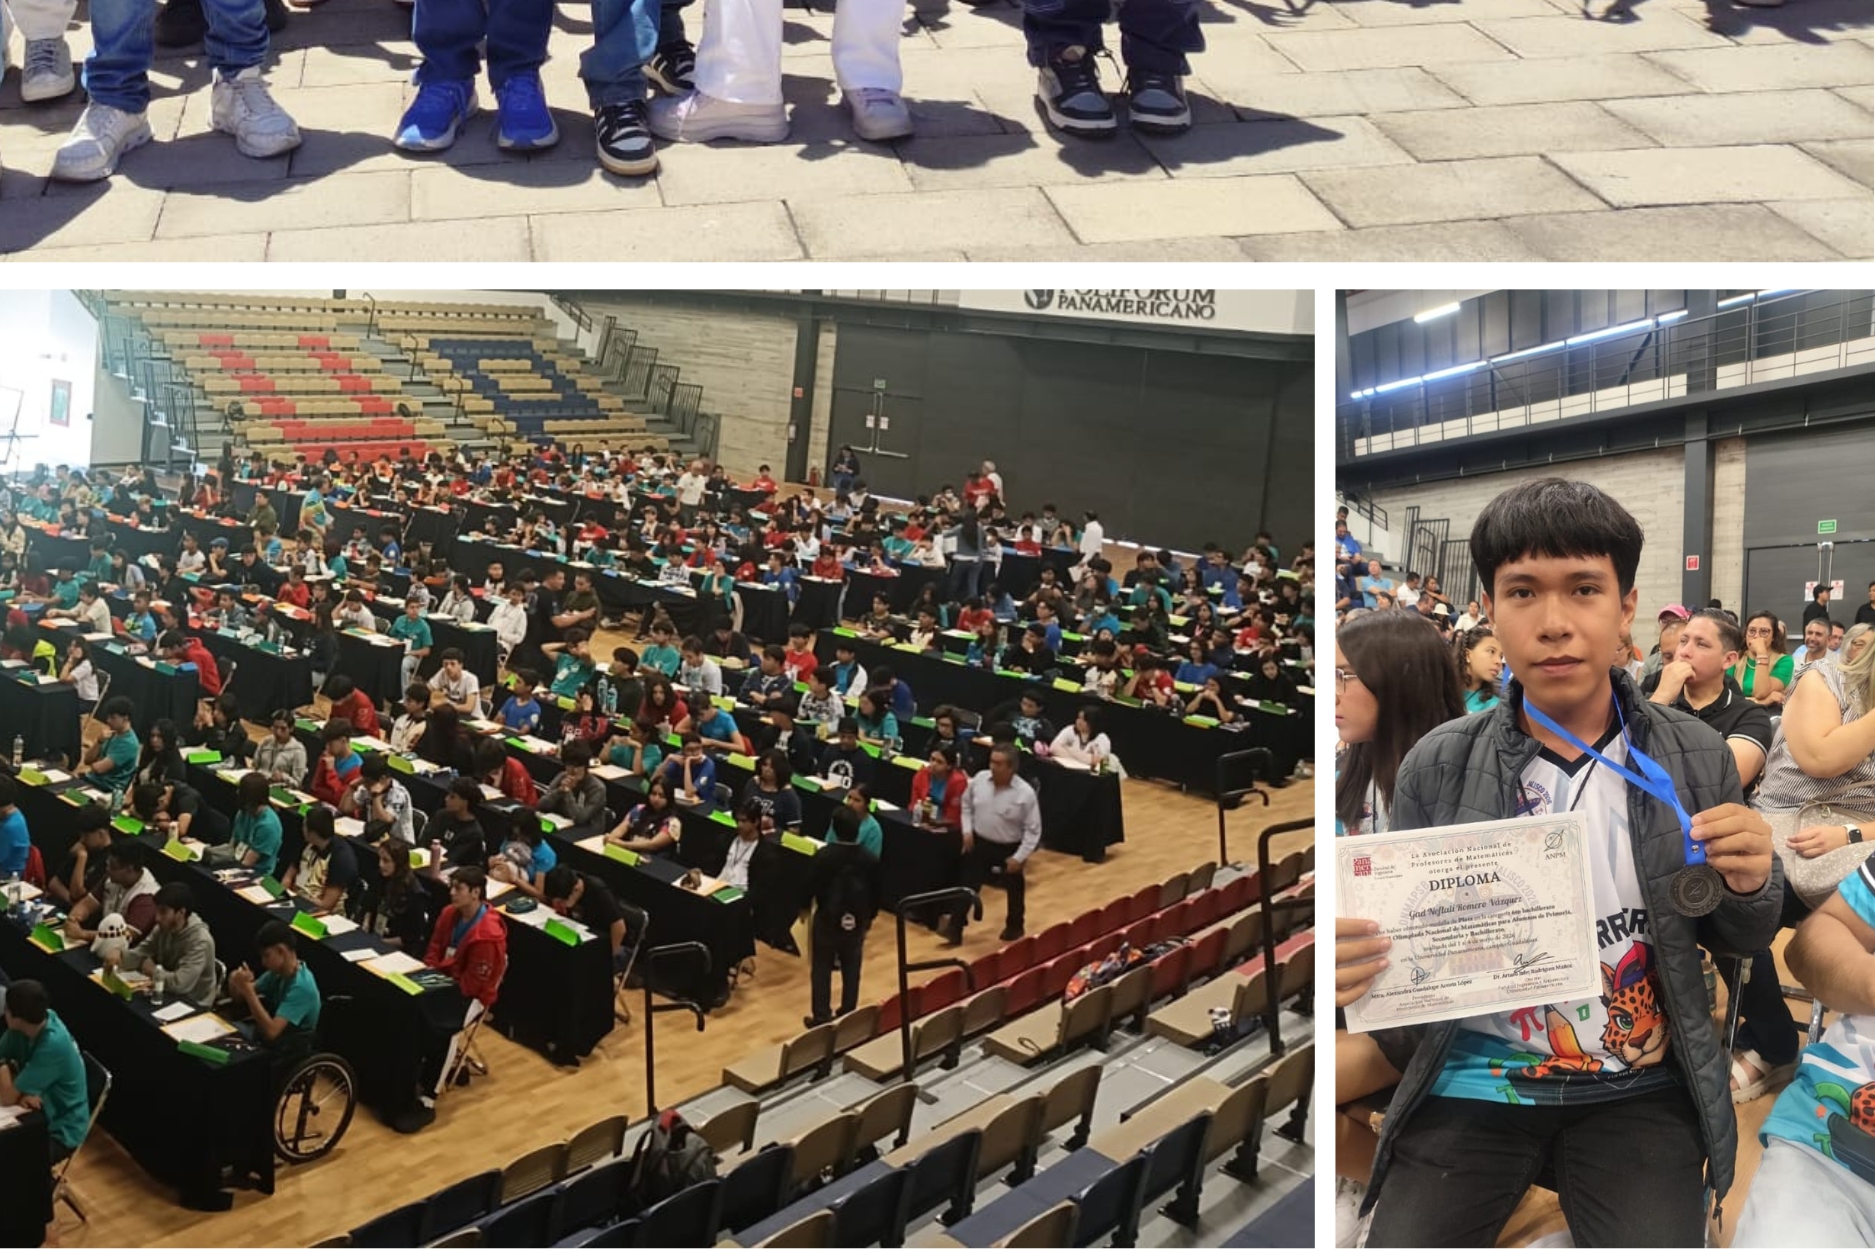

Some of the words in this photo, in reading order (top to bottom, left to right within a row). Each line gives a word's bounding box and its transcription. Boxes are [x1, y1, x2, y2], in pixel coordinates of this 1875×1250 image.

[1058, 294, 1216, 321] PANAMERICANO
[1467, 842, 1500, 852] Nacional
[1411, 858, 1451, 868] Profesores
[1466, 850, 1513, 861] Matemáticas
[1545, 852, 1566, 861] ANPM
[1465, 860, 1498, 870] presente
[1429, 871, 1501, 892] DIPLOMA
[1409, 909, 1426, 920] Gad
[1456, 901, 1486, 913] Romero
[1522, 904, 1555, 914] bachillerato
